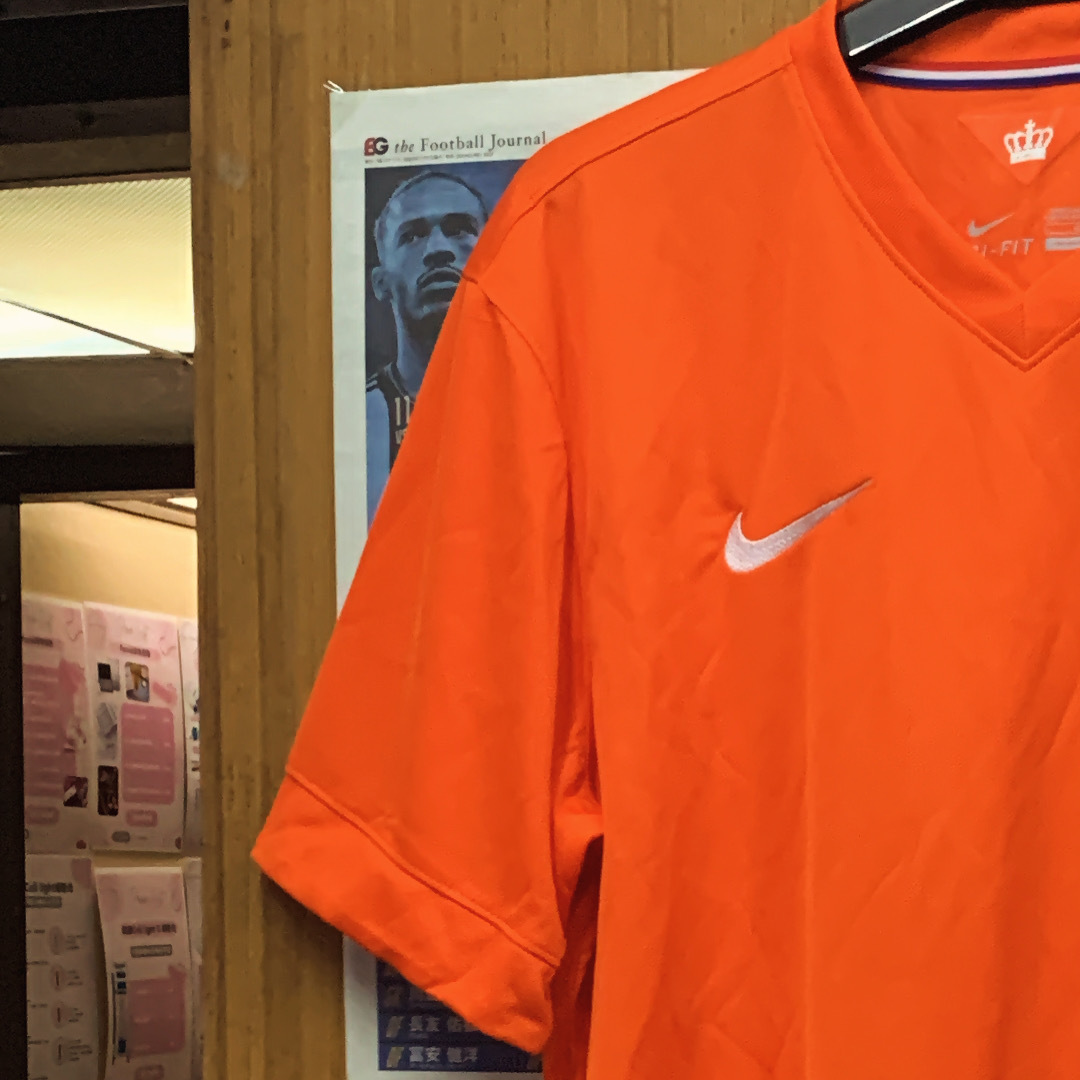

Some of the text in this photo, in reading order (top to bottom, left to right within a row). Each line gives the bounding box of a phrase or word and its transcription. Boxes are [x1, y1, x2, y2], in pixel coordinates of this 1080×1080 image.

[394, 140, 415, 153] the
[420, 135, 484, 152] Football
[489, 131, 546, 153] Journal
[972, 238, 1035, 258] I-FIT
